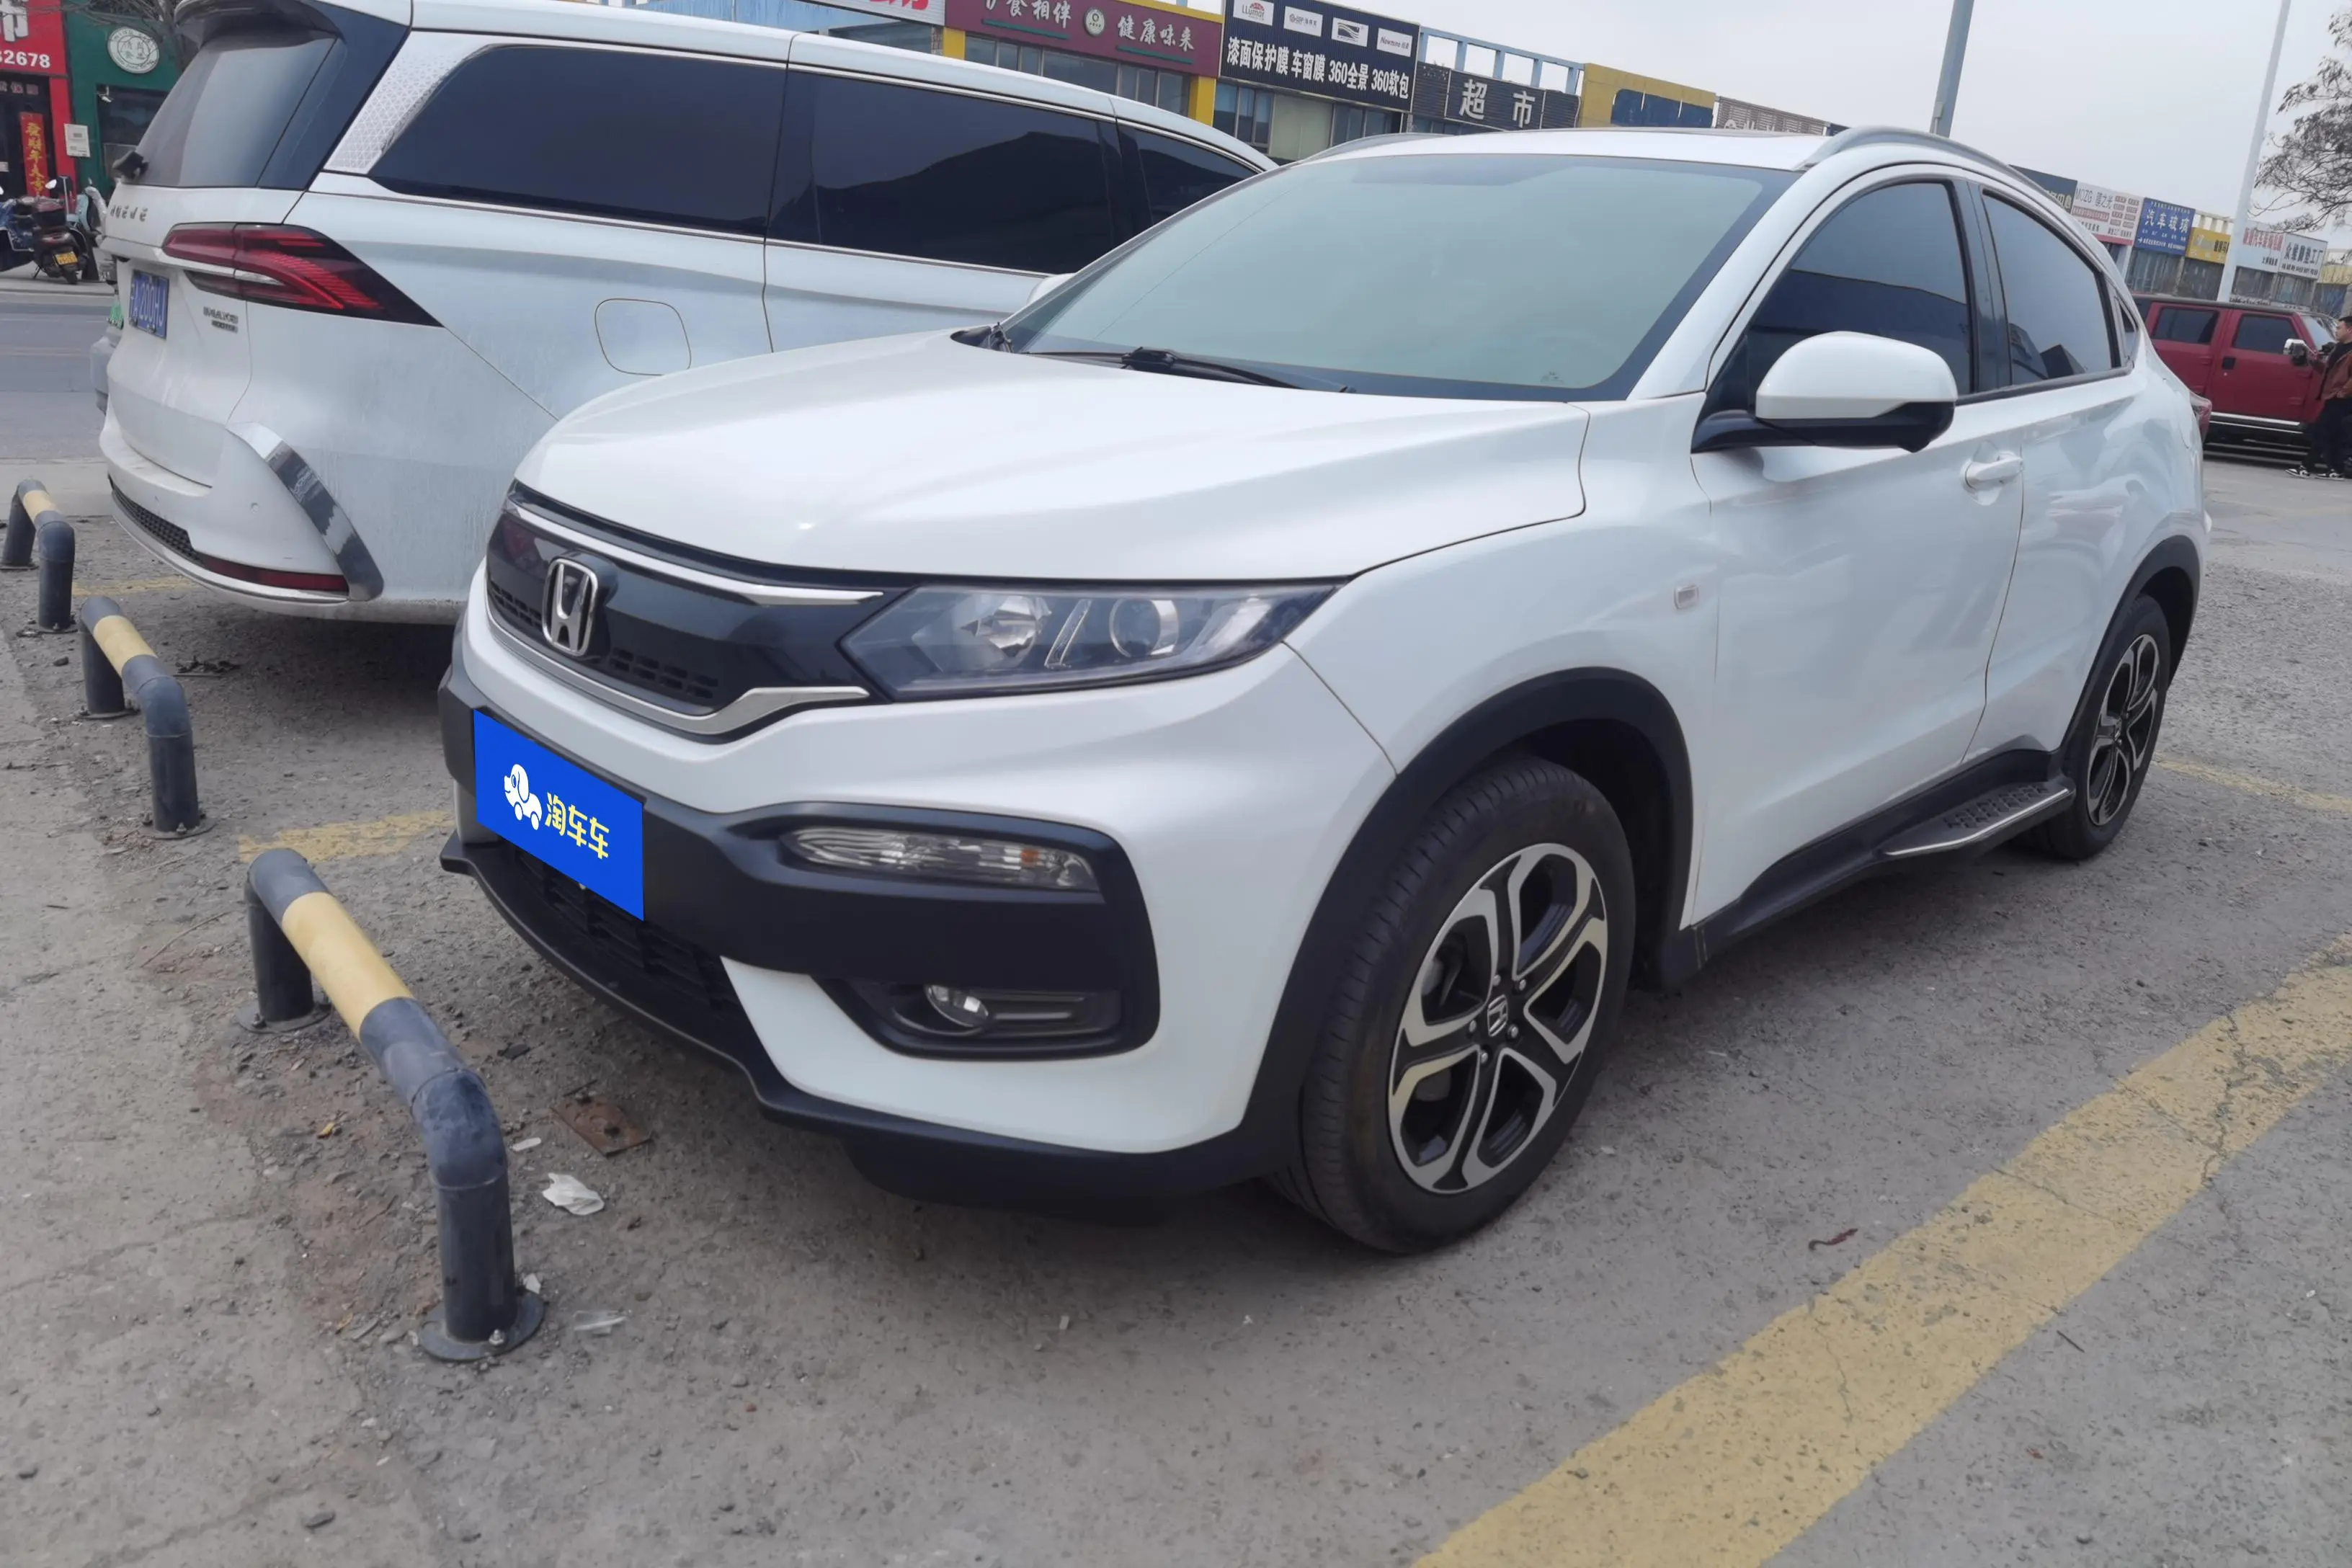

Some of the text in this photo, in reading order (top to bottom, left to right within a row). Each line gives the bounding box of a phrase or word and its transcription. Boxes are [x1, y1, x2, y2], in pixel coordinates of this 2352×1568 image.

[986, 0, 1072, 29] 食相伴
[1117, 15, 1194, 52] 健康味来
[1226, 37, 1409, 99] 漆面保护膜 车窗膜 360全景 360软包
[1458, 79, 1536, 128] 超市
[2144, 208, 2190, 233] 汽车玻璃
